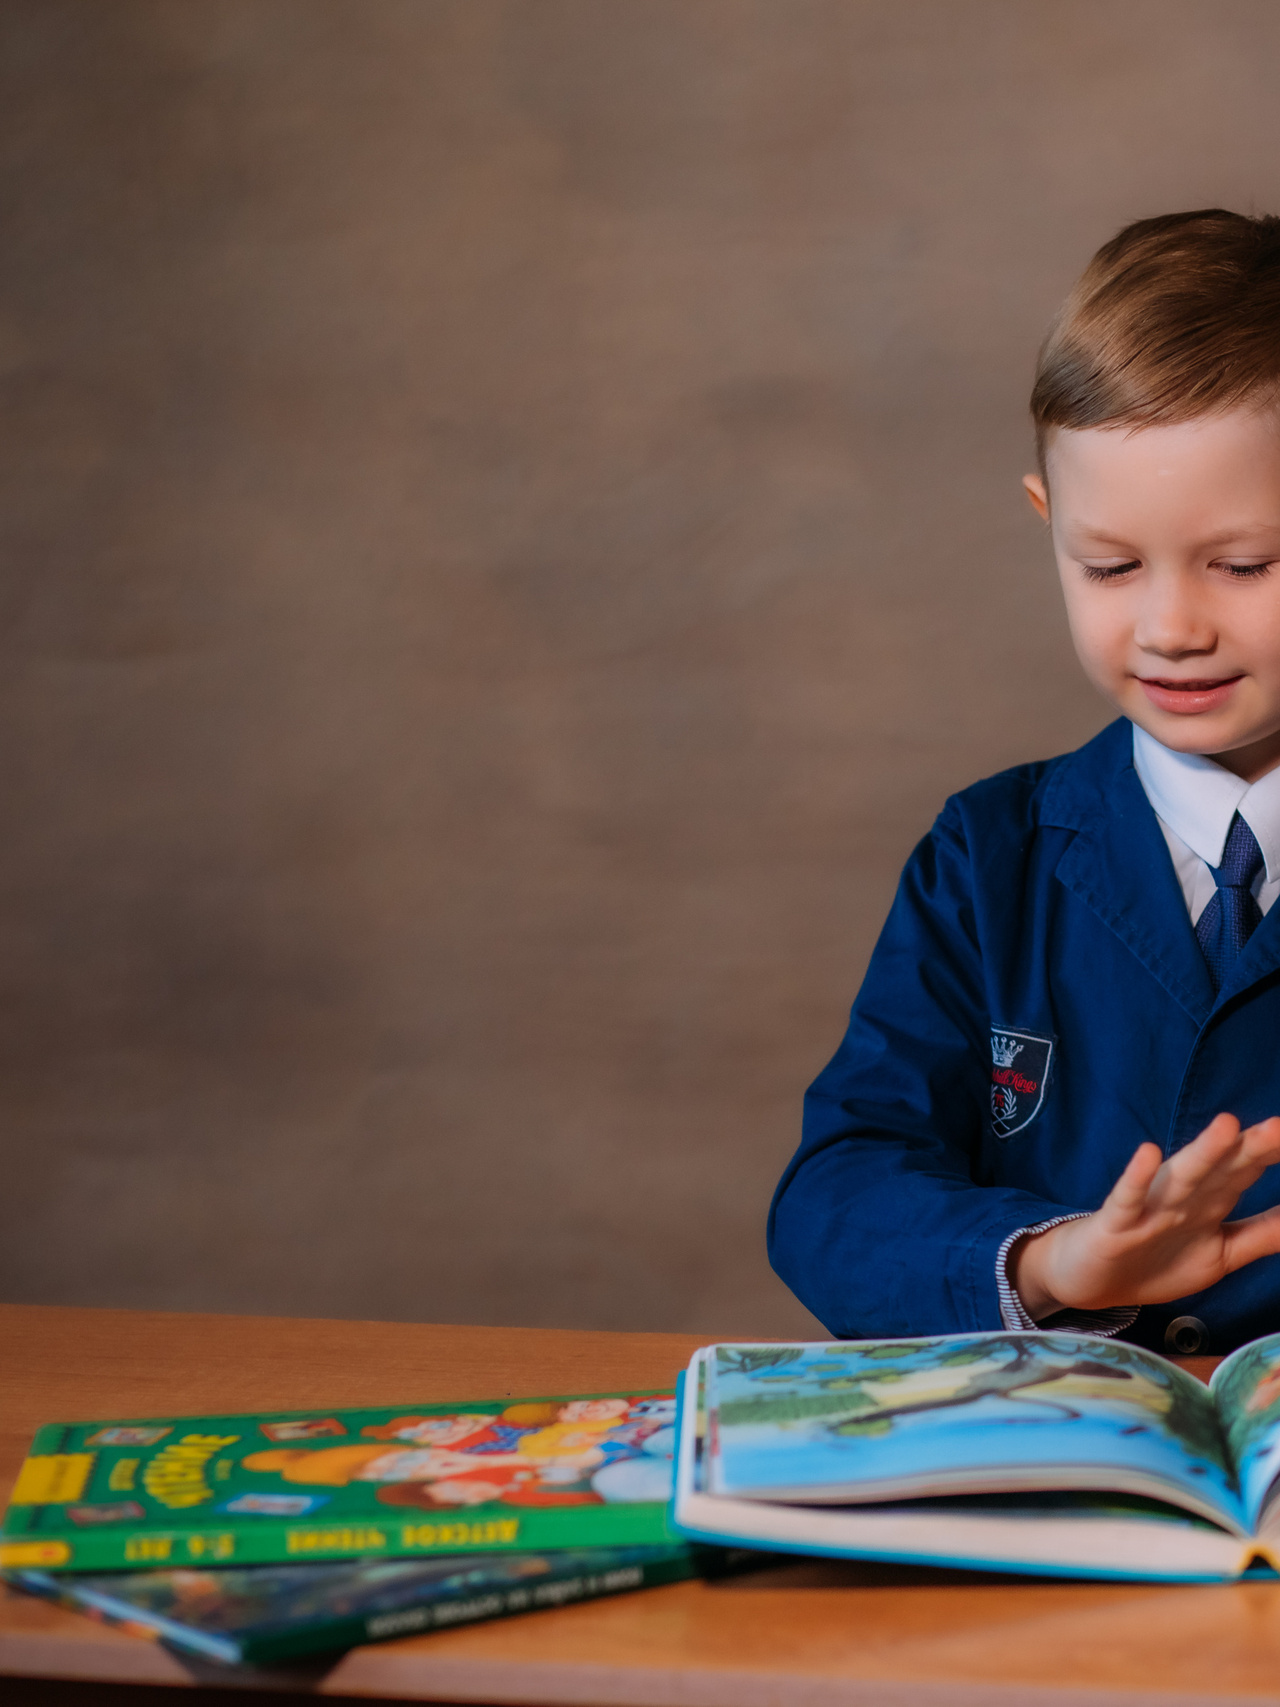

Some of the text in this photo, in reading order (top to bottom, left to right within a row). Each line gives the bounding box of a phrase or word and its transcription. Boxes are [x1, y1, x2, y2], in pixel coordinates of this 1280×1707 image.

[287, 1527, 387, 1553] ЧТЕНИЕ
[403, 1518, 519, 1548] ДЕТСКОЕ
[124, 1536, 173, 1561] ЛЕТ
